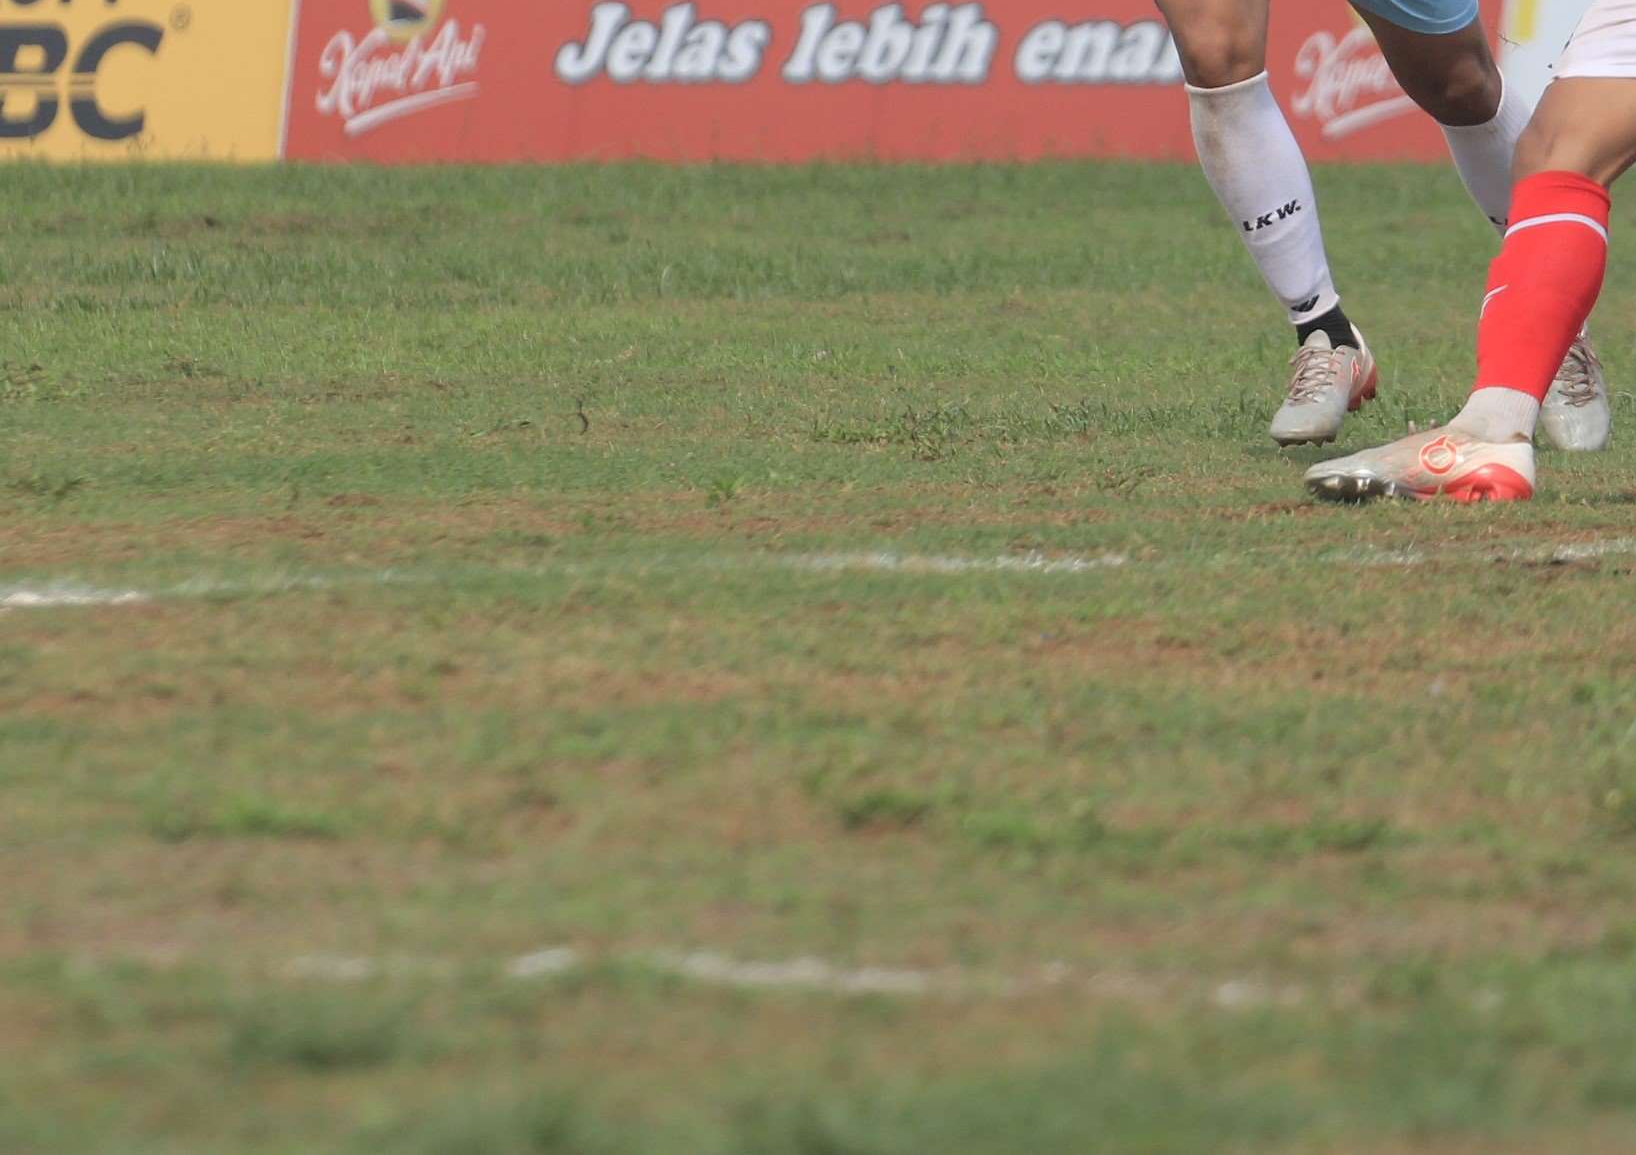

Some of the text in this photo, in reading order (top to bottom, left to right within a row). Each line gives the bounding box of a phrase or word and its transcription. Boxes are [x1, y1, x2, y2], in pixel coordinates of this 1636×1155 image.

[315, 18, 486, 118] Kapal Api
[556, 0, 1184, 85] Jelas lebih ena
